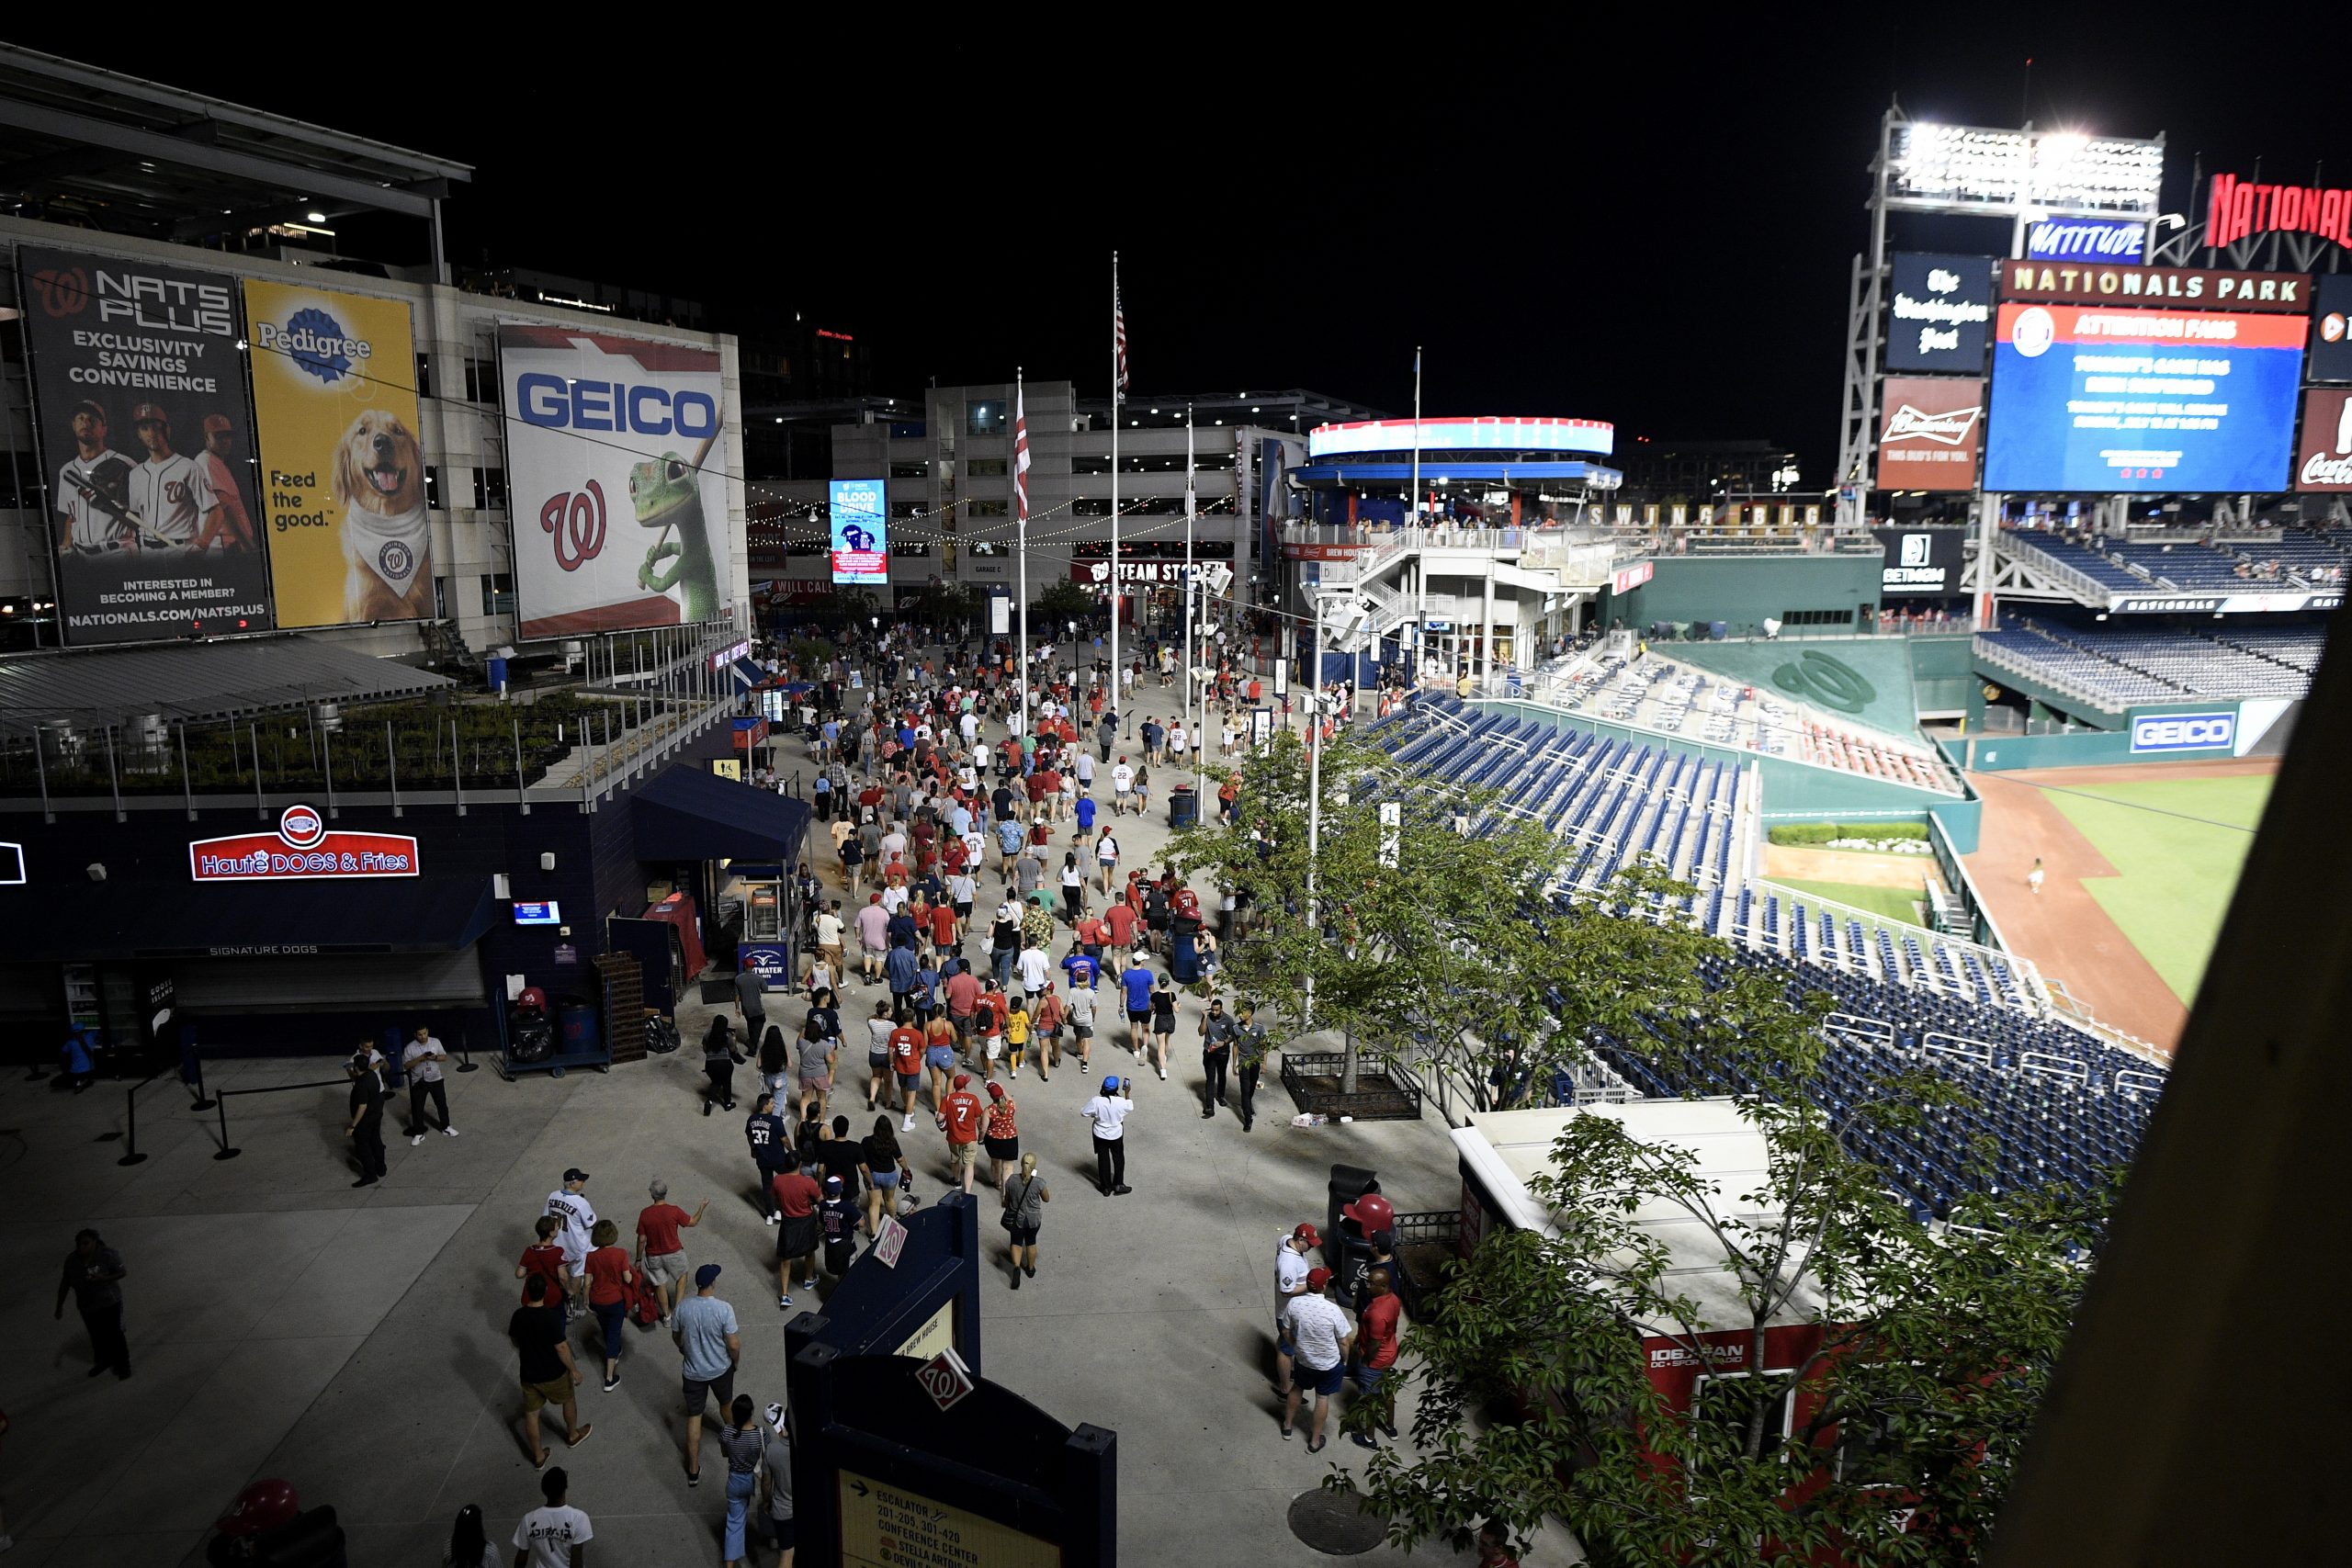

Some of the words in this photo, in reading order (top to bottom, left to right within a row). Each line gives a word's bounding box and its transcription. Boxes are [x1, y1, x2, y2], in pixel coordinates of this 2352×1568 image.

[2030, 223, 2145, 255] NATITUDE
[96, 270, 230, 310] NATS
[2014, 267, 2203, 298] NATIONALS
[2218, 278, 2299, 302] PARK
[98, 298, 232, 336] PLUS
[73, 330, 205, 357] EXCLUSIVITY
[256, 321, 371, 359] Pedigree
[98, 351, 187, 373] SAVINGS
[69, 367, 217, 393] CONVENIENCE
[517, 372, 717, 438] GEICO
[271, 470, 316, 489] Feed
[273, 491, 302, 509] the
[837, 491, 876, 502] BLOOD
[840, 502, 875, 514] DRIVE
[1590, 506, 1713, 525] SWING
[1752, 507, 1819, 525] BIG
[1343, 548, 1358, 557] HOU
[1118, 564, 1158, 581] TEAM
[123, 579, 197, 592] INTERESTED
[200, 578, 212, 587] IN
[777, 581, 802, 593] WILL
[807, 581, 832, 593] CALL
[100, 592, 166, 604] BECOMING
[170, 592, 178, 600] A
[181, 588, 235, 600] MEMBER?
[69, 604, 265, 627] NATIONALS.COM/NATSPLUS
[2134, 719, 2230, 747] GEICO
[201, 853, 269, 874] Haute
[271, 852, 338, 873] DOGS
[342, 853, 357, 871] &
[360, 852, 409, 871] Fries
[209, 945, 279, 956] SIGNATURE
[282, 945, 318, 954] DOGS
[151, 977, 172, 996] GOOSE
[152, 987, 174, 1004] ISLAND
[897, 1043, 910, 1056] 22
[957, 1107, 967, 1122] 7
[752, 1129, 770, 1145] 37
[548, 1199, 577, 1215] SCHERZER
[824, 1216, 841, 1232] 31
[906, 1333, 922, 1355] BREW
[922, 1317, 938, 1340] HOUSE
[876, 1490, 929, 1517] ESCALATOR
[922, 1519, 960, 1544] 301-420
[878, 1519, 939, 1551] CONFERENCE
[942, 1542, 978, 1564] CENTER
[899, 1541, 930, 1562] STELLA
